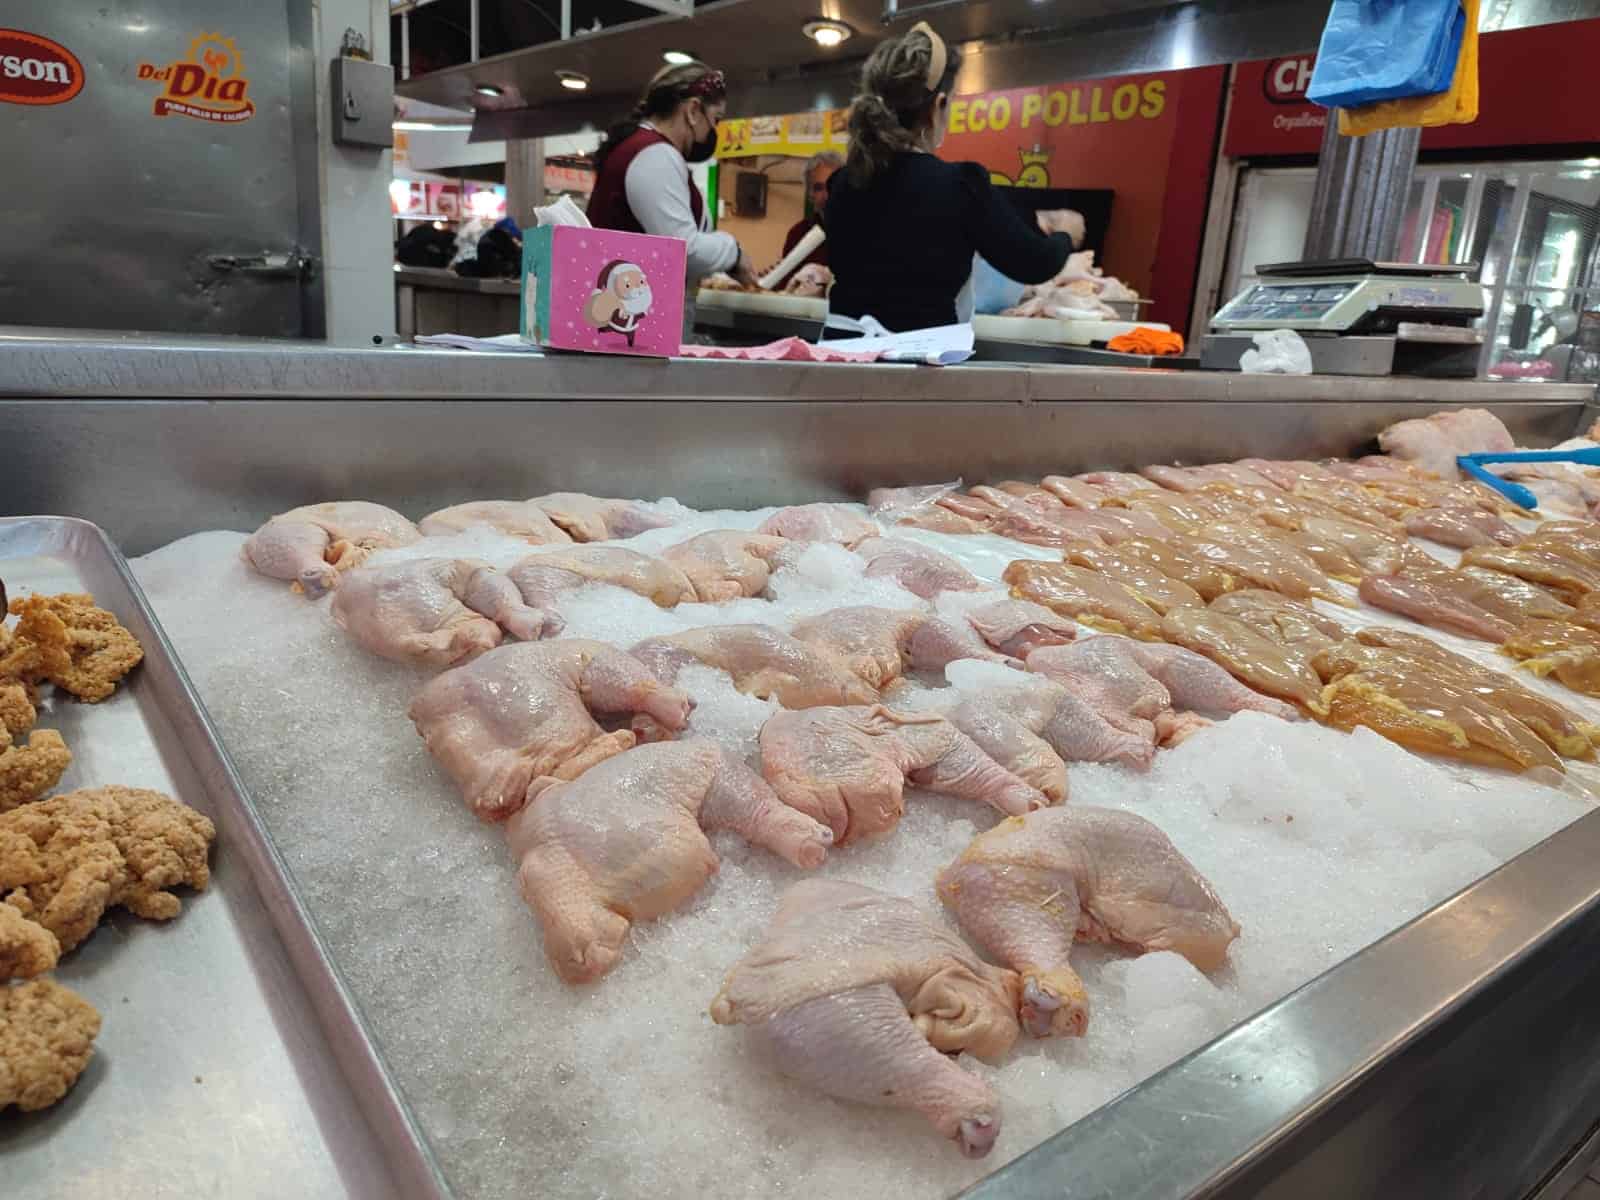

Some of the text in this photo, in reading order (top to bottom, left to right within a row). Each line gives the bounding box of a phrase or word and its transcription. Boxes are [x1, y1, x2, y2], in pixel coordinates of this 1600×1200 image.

[0, 55, 71, 84] son
[138, 64, 172, 80] Del
[948, 79, 1166, 133] ECO POLLOS
